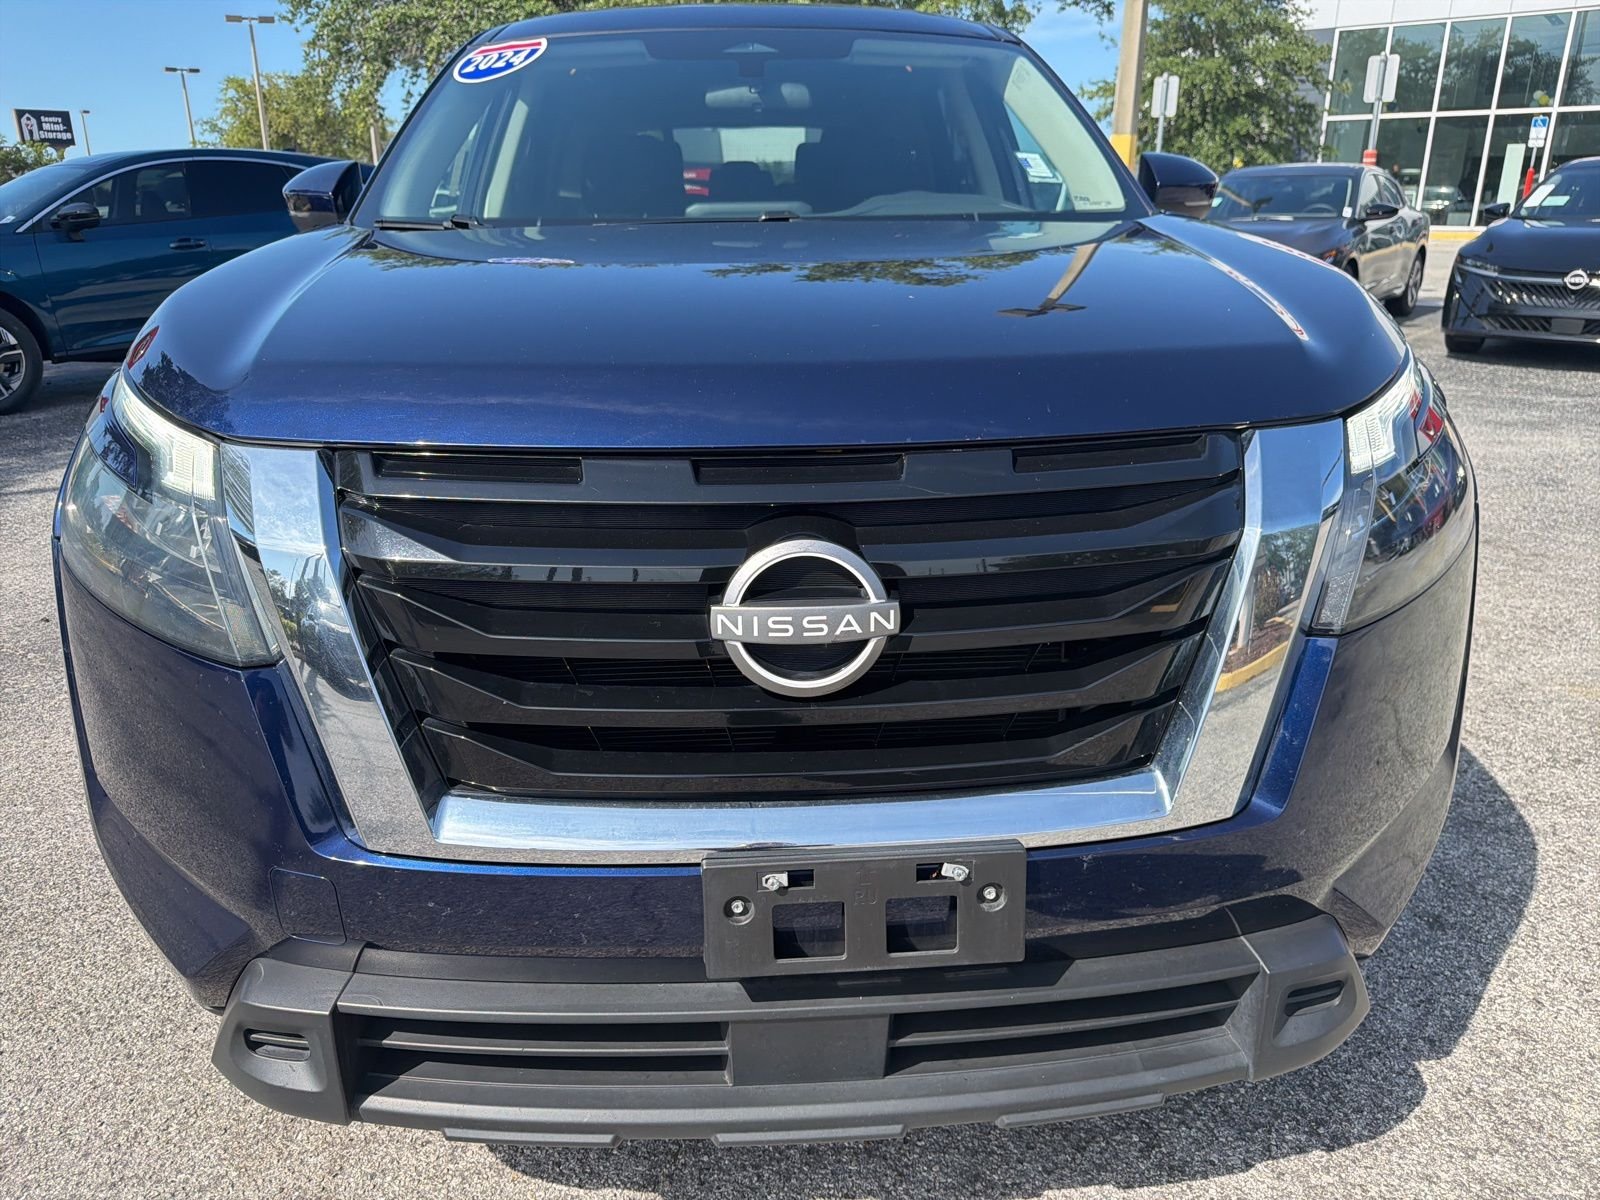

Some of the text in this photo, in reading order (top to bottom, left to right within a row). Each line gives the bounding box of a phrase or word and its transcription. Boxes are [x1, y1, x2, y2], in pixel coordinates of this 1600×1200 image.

[460, 48, 531, 74] 2024
[39, 131, 72, 140] Storage
[42, 123, 67, 131] Mini-
[716, 609, 895, 637] NISSAN
